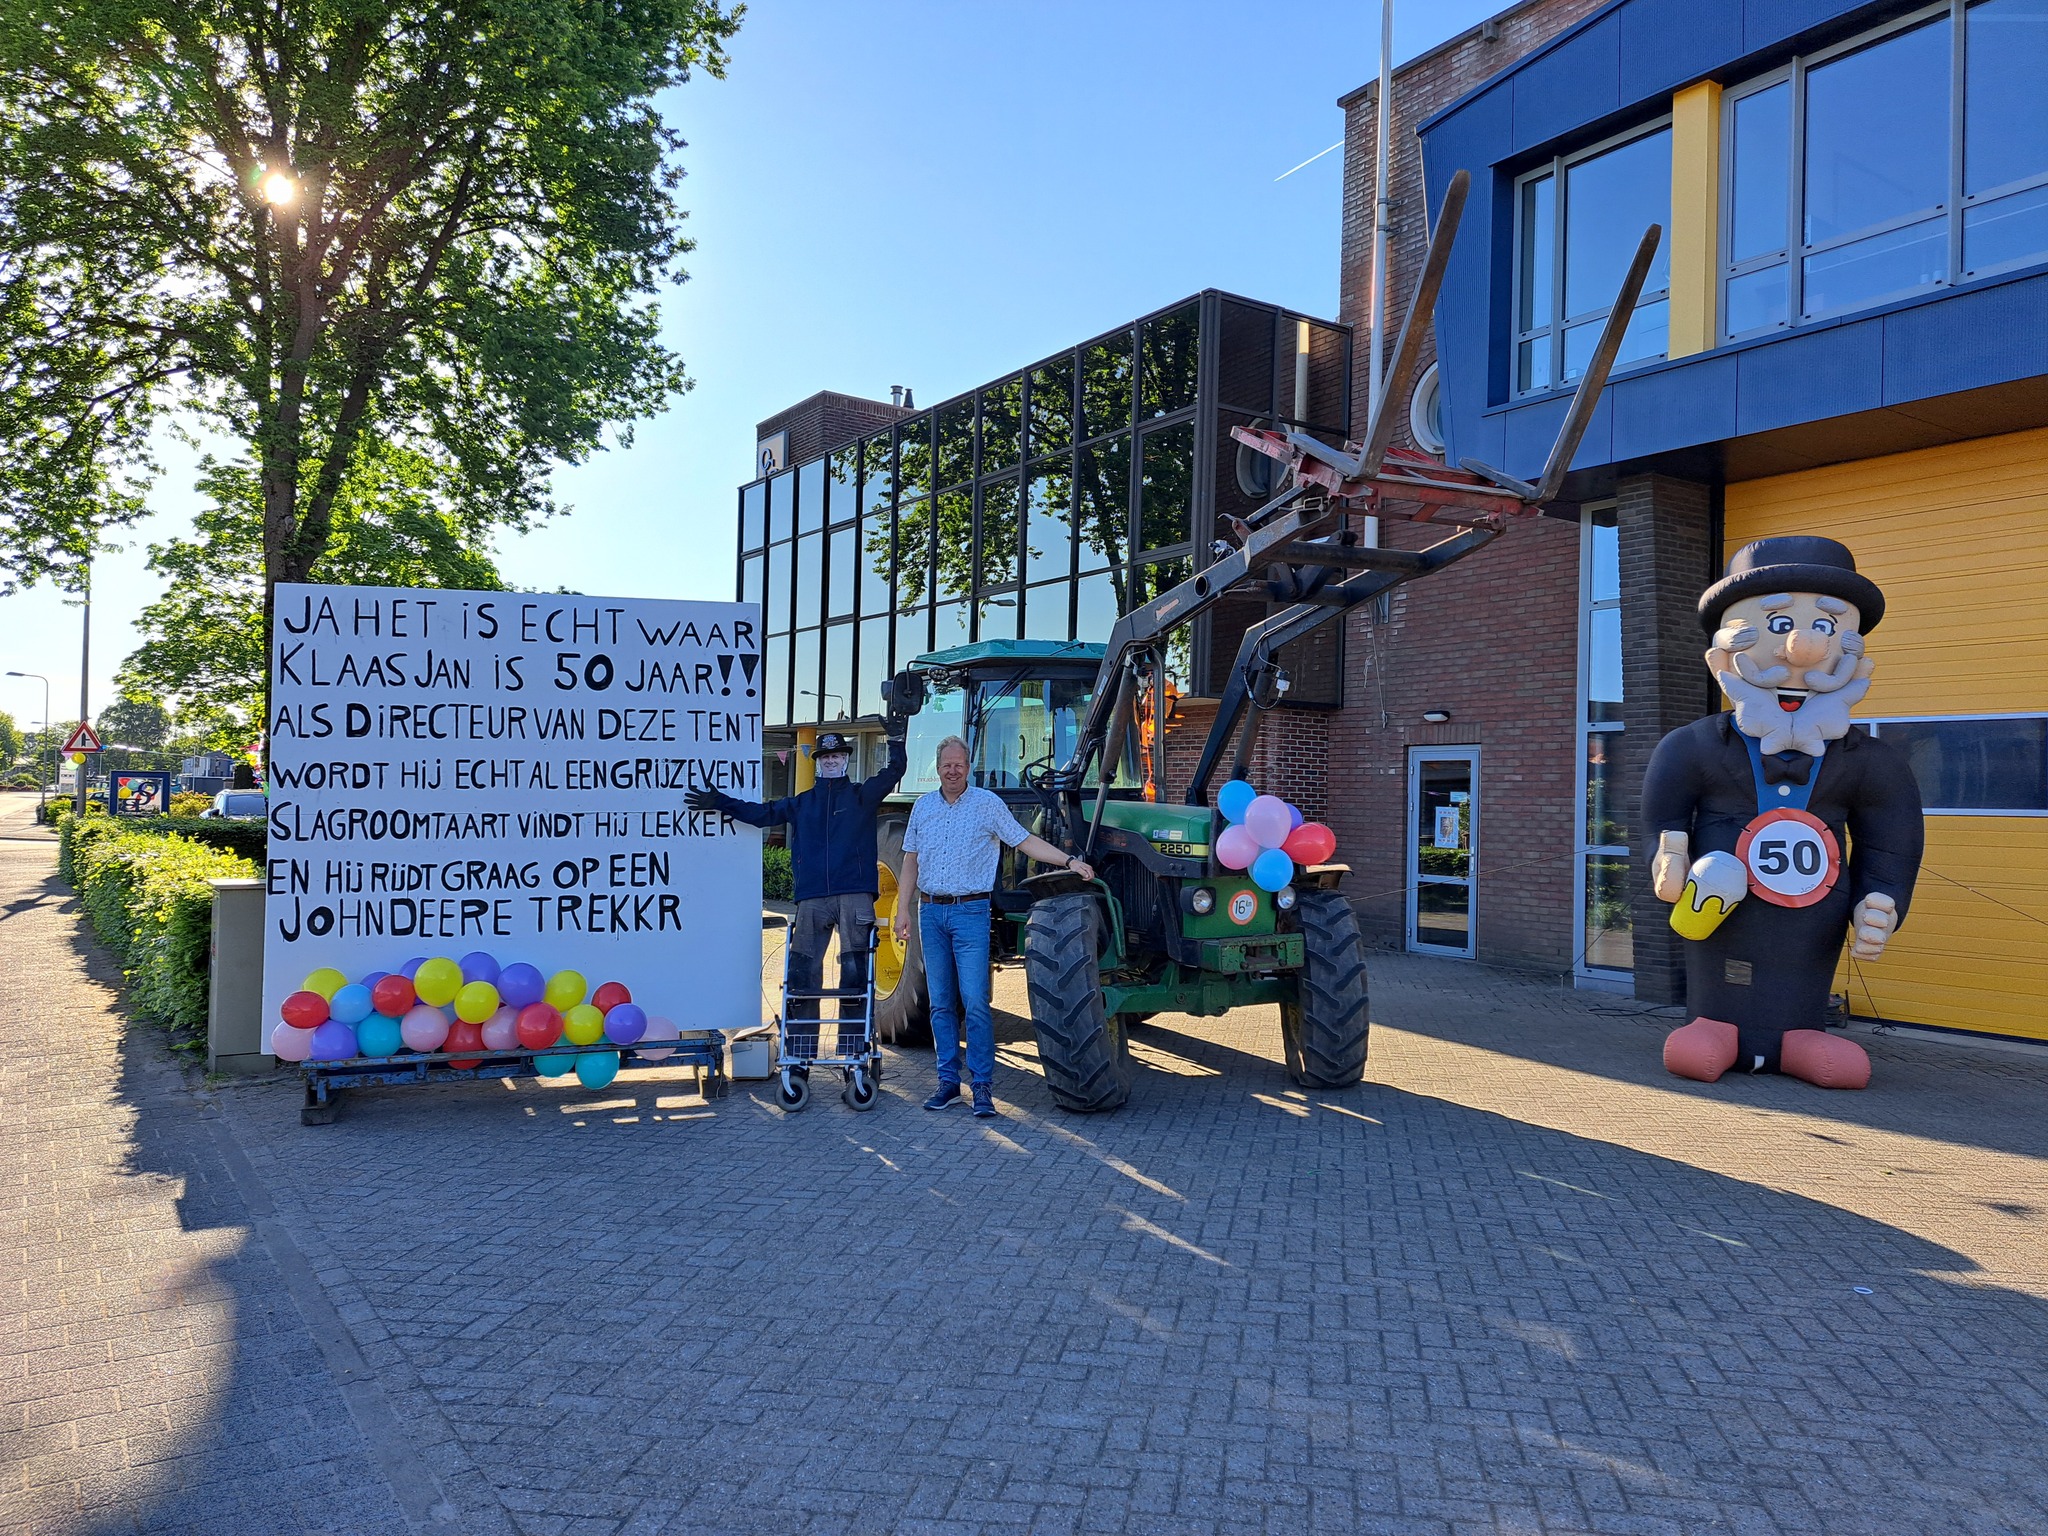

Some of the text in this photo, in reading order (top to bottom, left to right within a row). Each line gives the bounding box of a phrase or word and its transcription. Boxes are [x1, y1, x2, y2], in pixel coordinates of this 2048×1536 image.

[283, 595, 340, 636] JA
[353, 598, 438, 639] HET
[521, 603, 626, 645] ECHT
[636, 618, 756, 650] WAAR
[553, 652, 615, 692] 50
[624, 653, 761, 697] JAAR!!
[271, 702, 334, 739] ALS
[532, 707, 585, 741] VAN
[597, 708, 676, 742] DEZE
[686, 710, 761, 743] TENT
[270, 760, 390, 790] WORDT
[455, 758, 525, 790] ECHT
[528, 760, 559, 790] AL
[565, 759, 607, 791] EEN
[698, 759, 761, 790] VENT
[269, 801, 511, 842] SLAGROOMTAART
[641, 809, 737, 838] LEKKER
[1160, 843, 1191, 854] 2250
[1757, 839, 1822, 876] 50
[266, 858, 310, 896] EN
[440, 860, 541, 892] GRAAG
[552, 857, 600, 890] OP
[609, 850, 670, 889] EEN
[278, 892, 682, 943] JOHN DEERE TREKKR
[1235, 900, 1246, 914] 16
